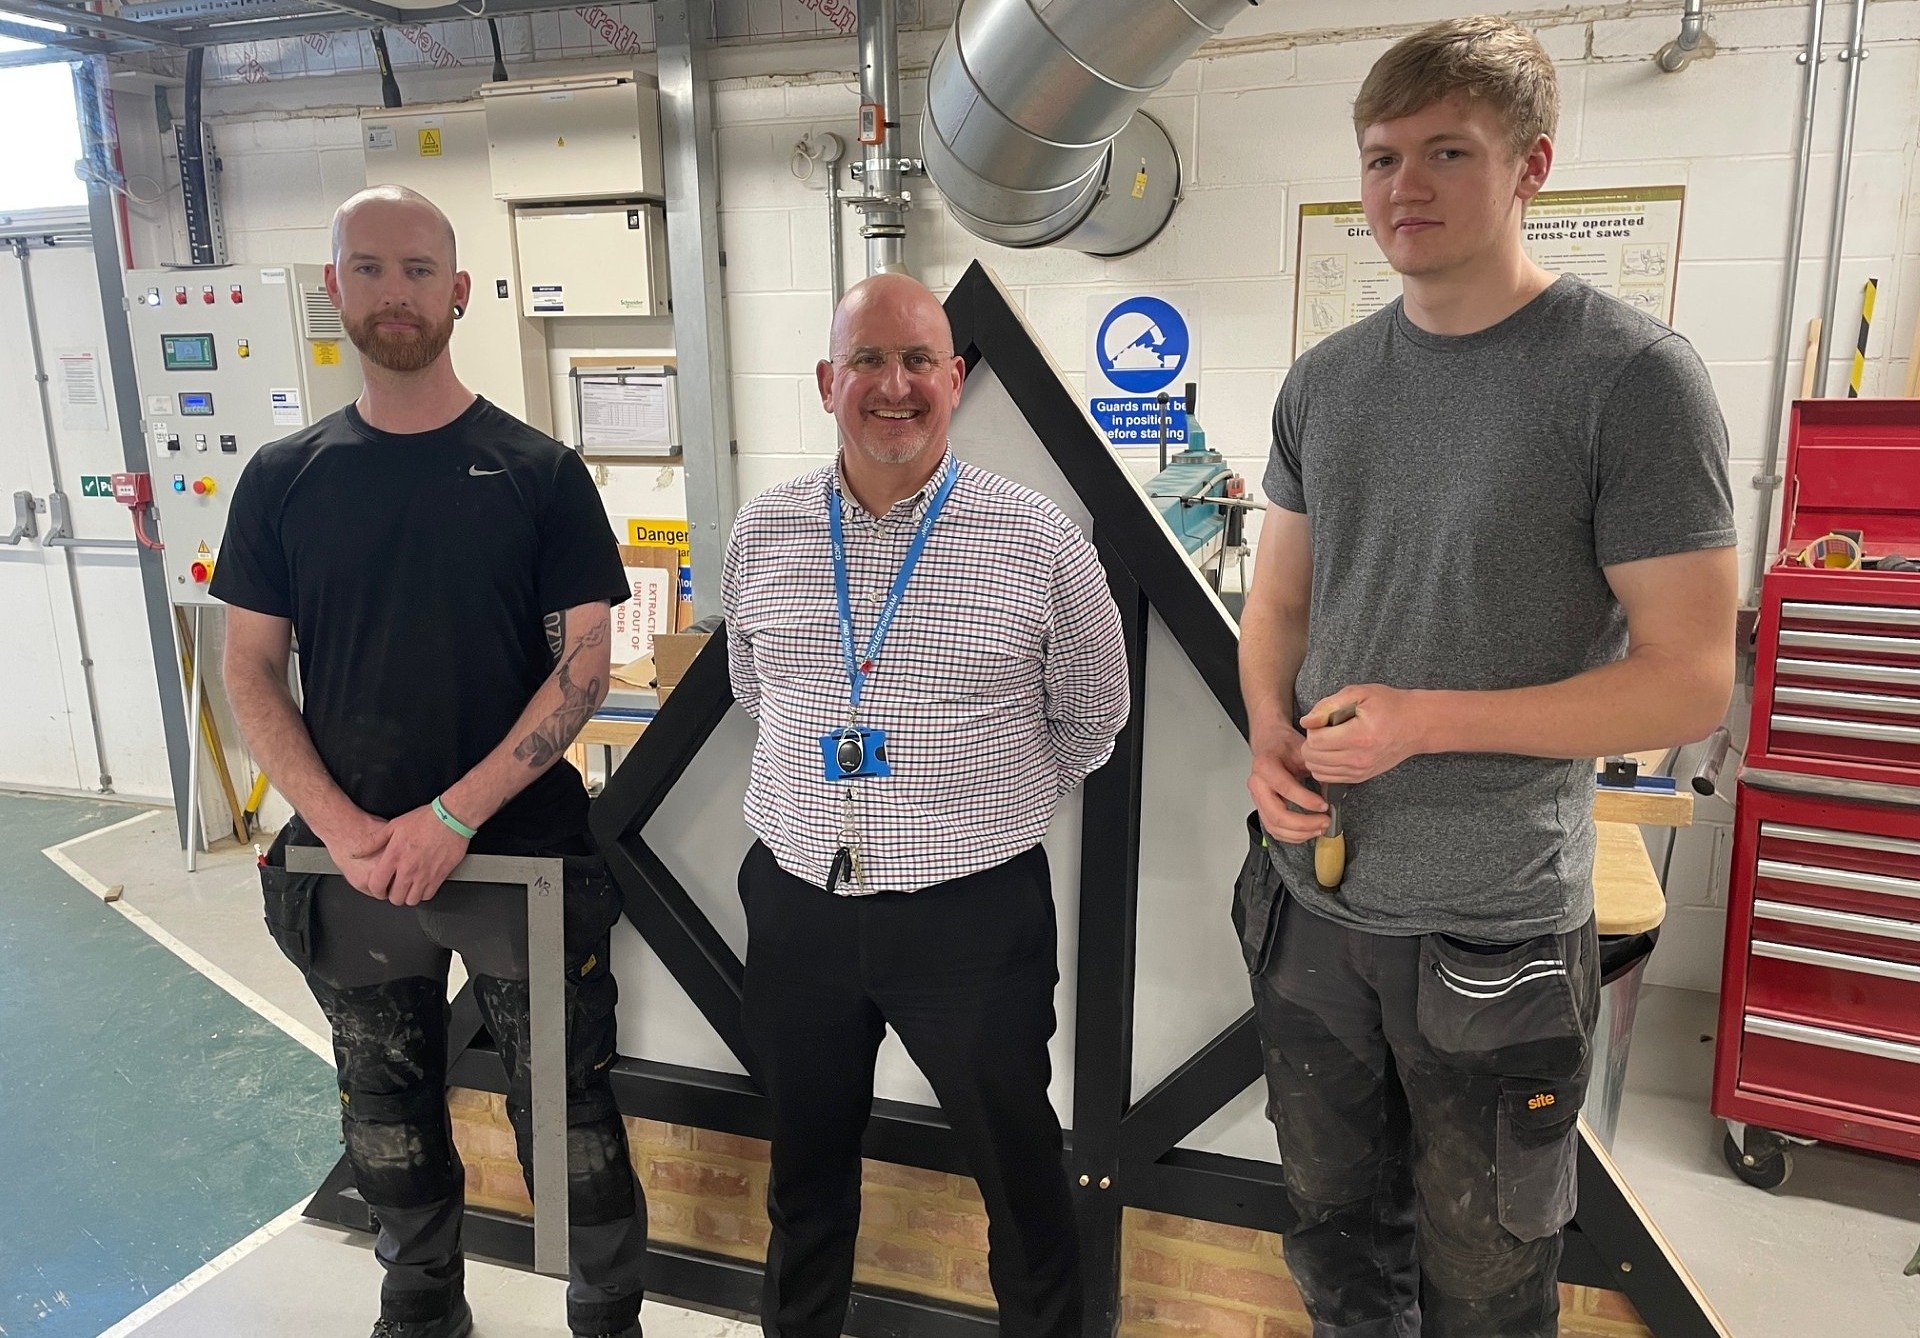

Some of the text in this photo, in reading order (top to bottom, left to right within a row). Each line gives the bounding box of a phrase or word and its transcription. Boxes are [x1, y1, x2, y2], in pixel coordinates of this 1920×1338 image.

[1582, 217, 1644, 230] operated
[1527, 229, 1631, 241] cross-cut saws
[1097, 401, 1138, 412] Guards
[1142, 402, 1170, 411] mut
[1112, 415, 1122, 425] in
[637, 526, 688, 545] Danger
[617, 603, 626, 633] RDER
[631, 582, 642, 651] UNIT OUT OF
[647, 583, 657, 650] EXTRACTION
[868, 594, 899, 659] COLLEGE DURHAM
[1528, 1094, 1555, 1109] site
